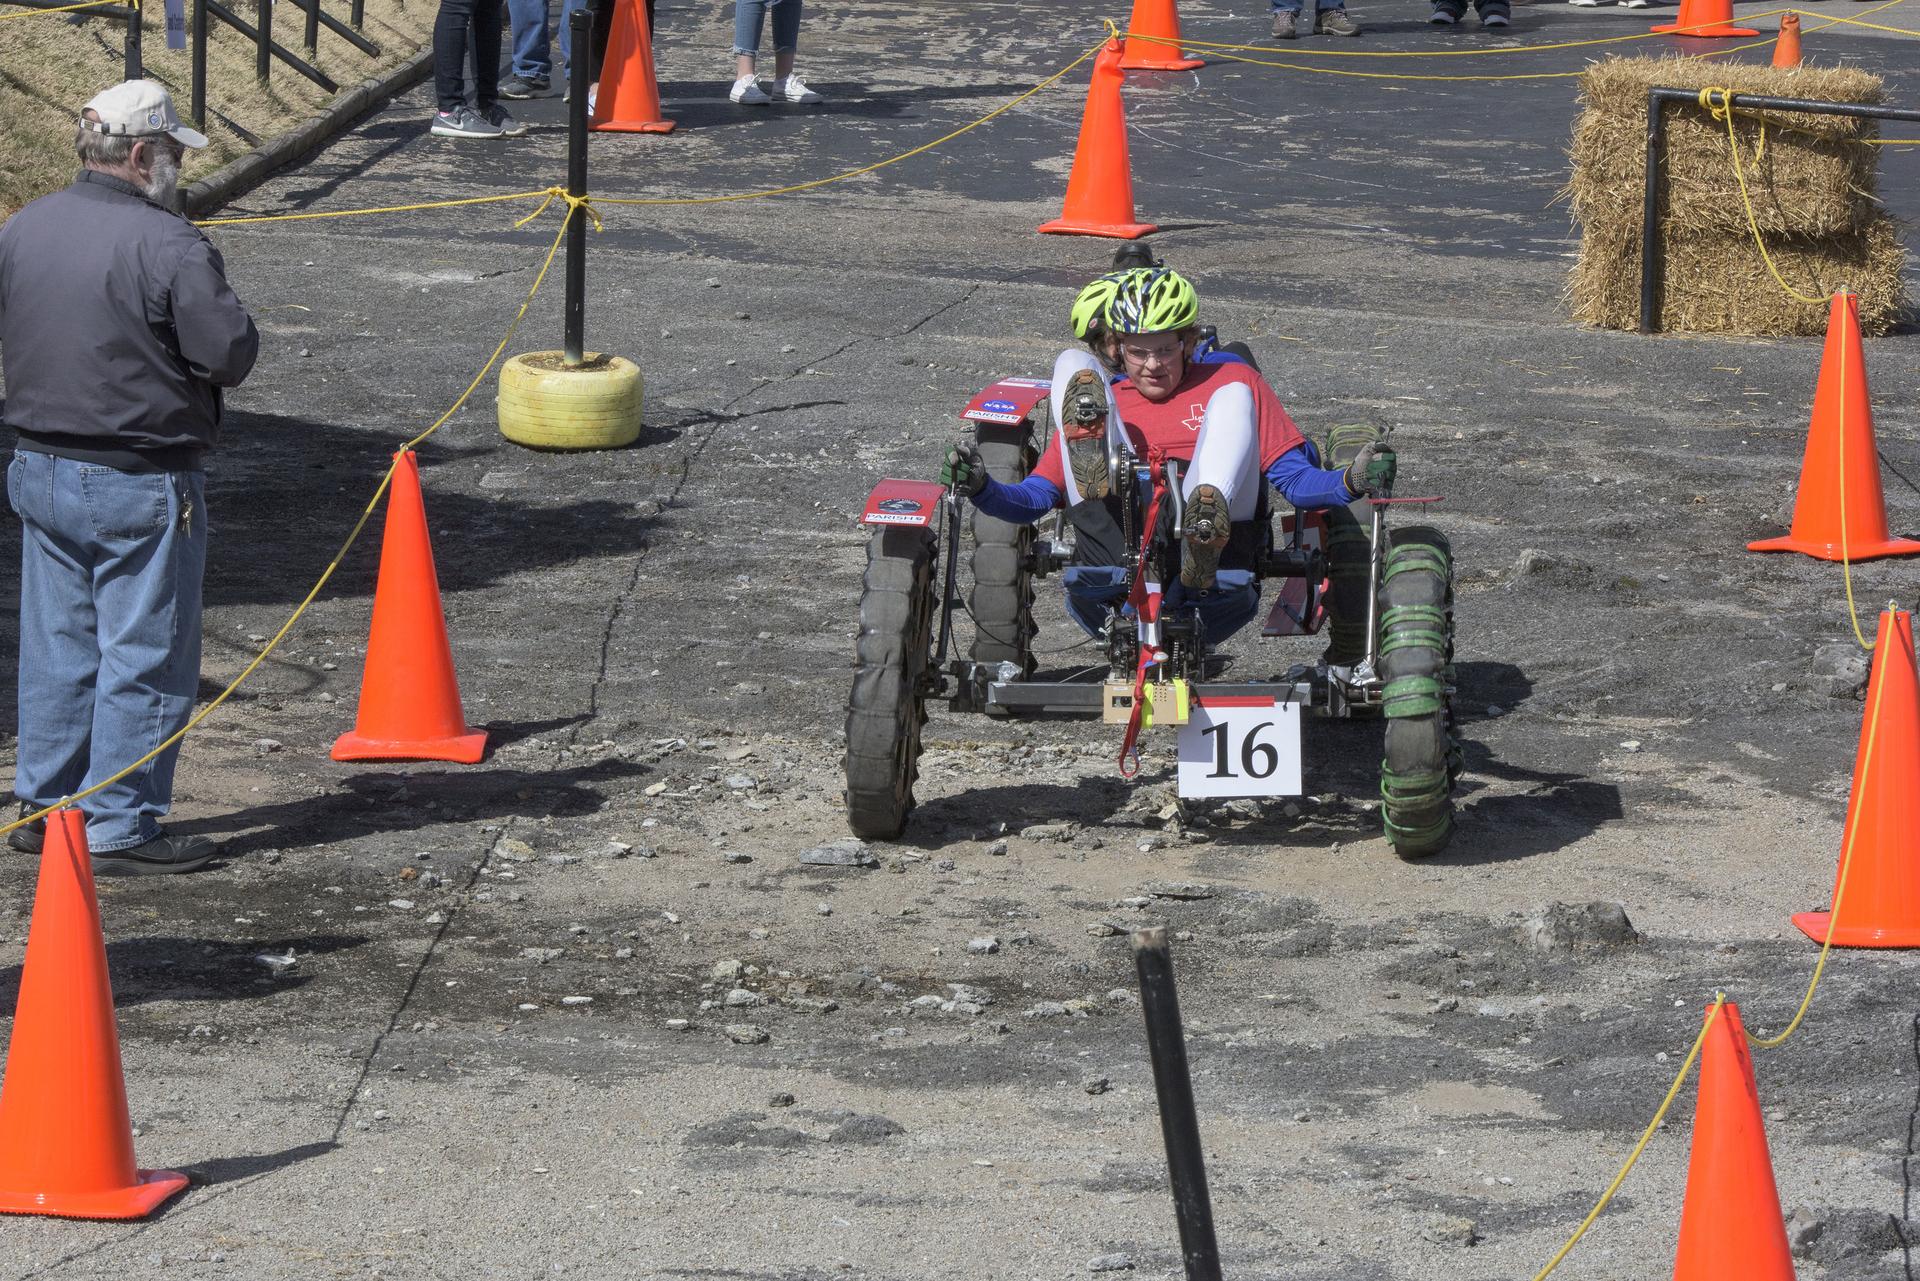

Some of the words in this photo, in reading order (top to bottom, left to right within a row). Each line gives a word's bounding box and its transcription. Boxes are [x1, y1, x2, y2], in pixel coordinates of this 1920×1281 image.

[984, 402, 1016, 411] NASA
[967, 410, 1013, 419] PARISH
[867, 513, 914, 521] PARISH
[1201, 721, 1279, 779] 16
